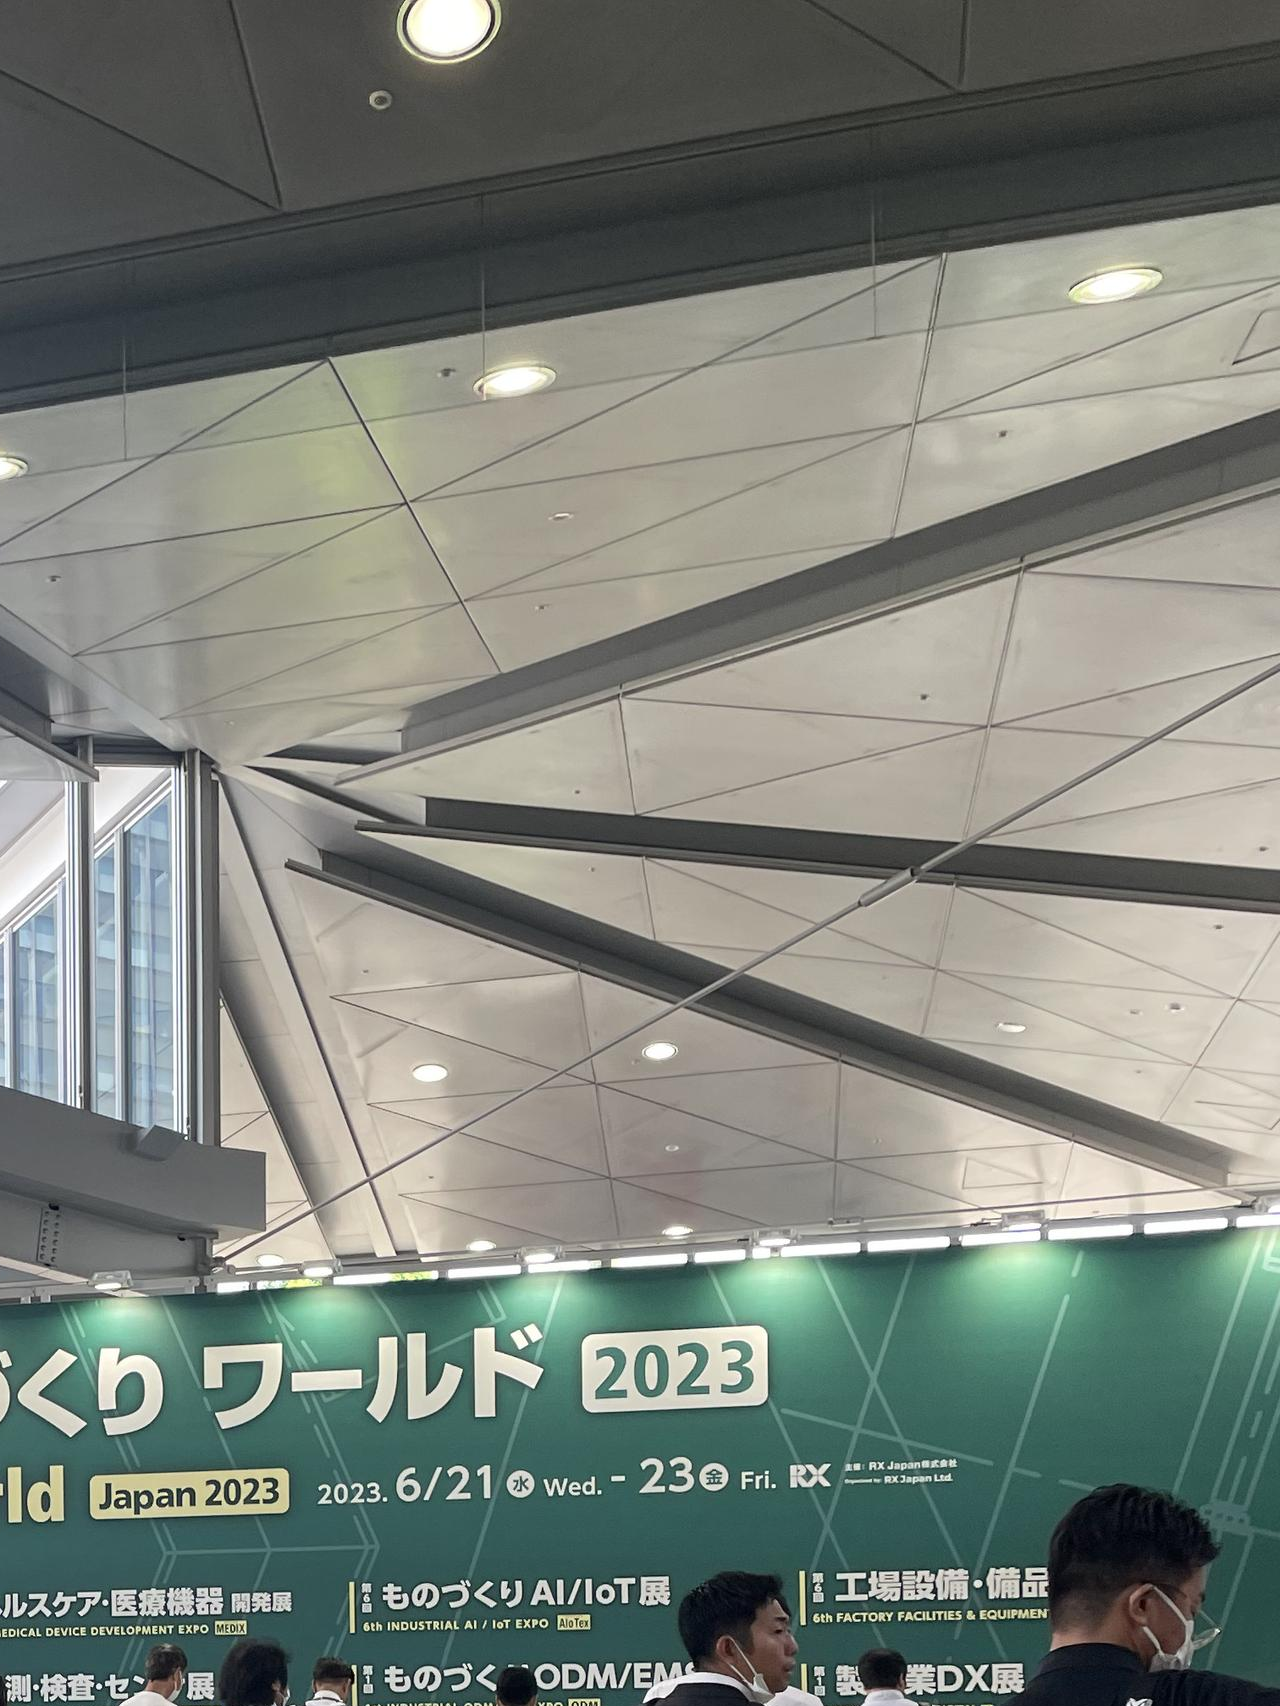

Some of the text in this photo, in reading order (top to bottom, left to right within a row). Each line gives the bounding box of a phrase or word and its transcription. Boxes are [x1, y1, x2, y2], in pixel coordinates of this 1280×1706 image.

[202, 1322, 545, 1431] ワールド
[593, 1340, 756, 1400] 2023
[317, 1482, 389, 1506] 2023.
[395, 1464, 494, 1502] 6/21
[543, 1475, 602, 1498] Wed.
[740, 1471, 777, 1491] Fri.
[789, 1463, 832, 1489] RX
[899, 1474, 933, 1485] Japan
[98, 1477, 281, 1514] Japan 2023
[231, 1591, 293, 1614] 開発展
[362, 1621, 383, 1632] 6th
[387, 1620, 460, 1631] INDUSTRIAL
[464, 1620, 478, 1630] AI
[492, 1618, 511, 1630] IoT
[515, 1618, 549, 1630] EXPO
[812, 1608, 1049, 1624] 6th FACTORY FACILITIES & EQUIPMEN
[45, 1626, 87, 1637] DEVICE
[90, 1625, 175, 1636] DEVELOPMENT
[178, 1624, 210, 1635] EXPO
[216, 1623, 246, 1634] MEDIX
[835, 1663, 1025, 1696] 製業DX展
